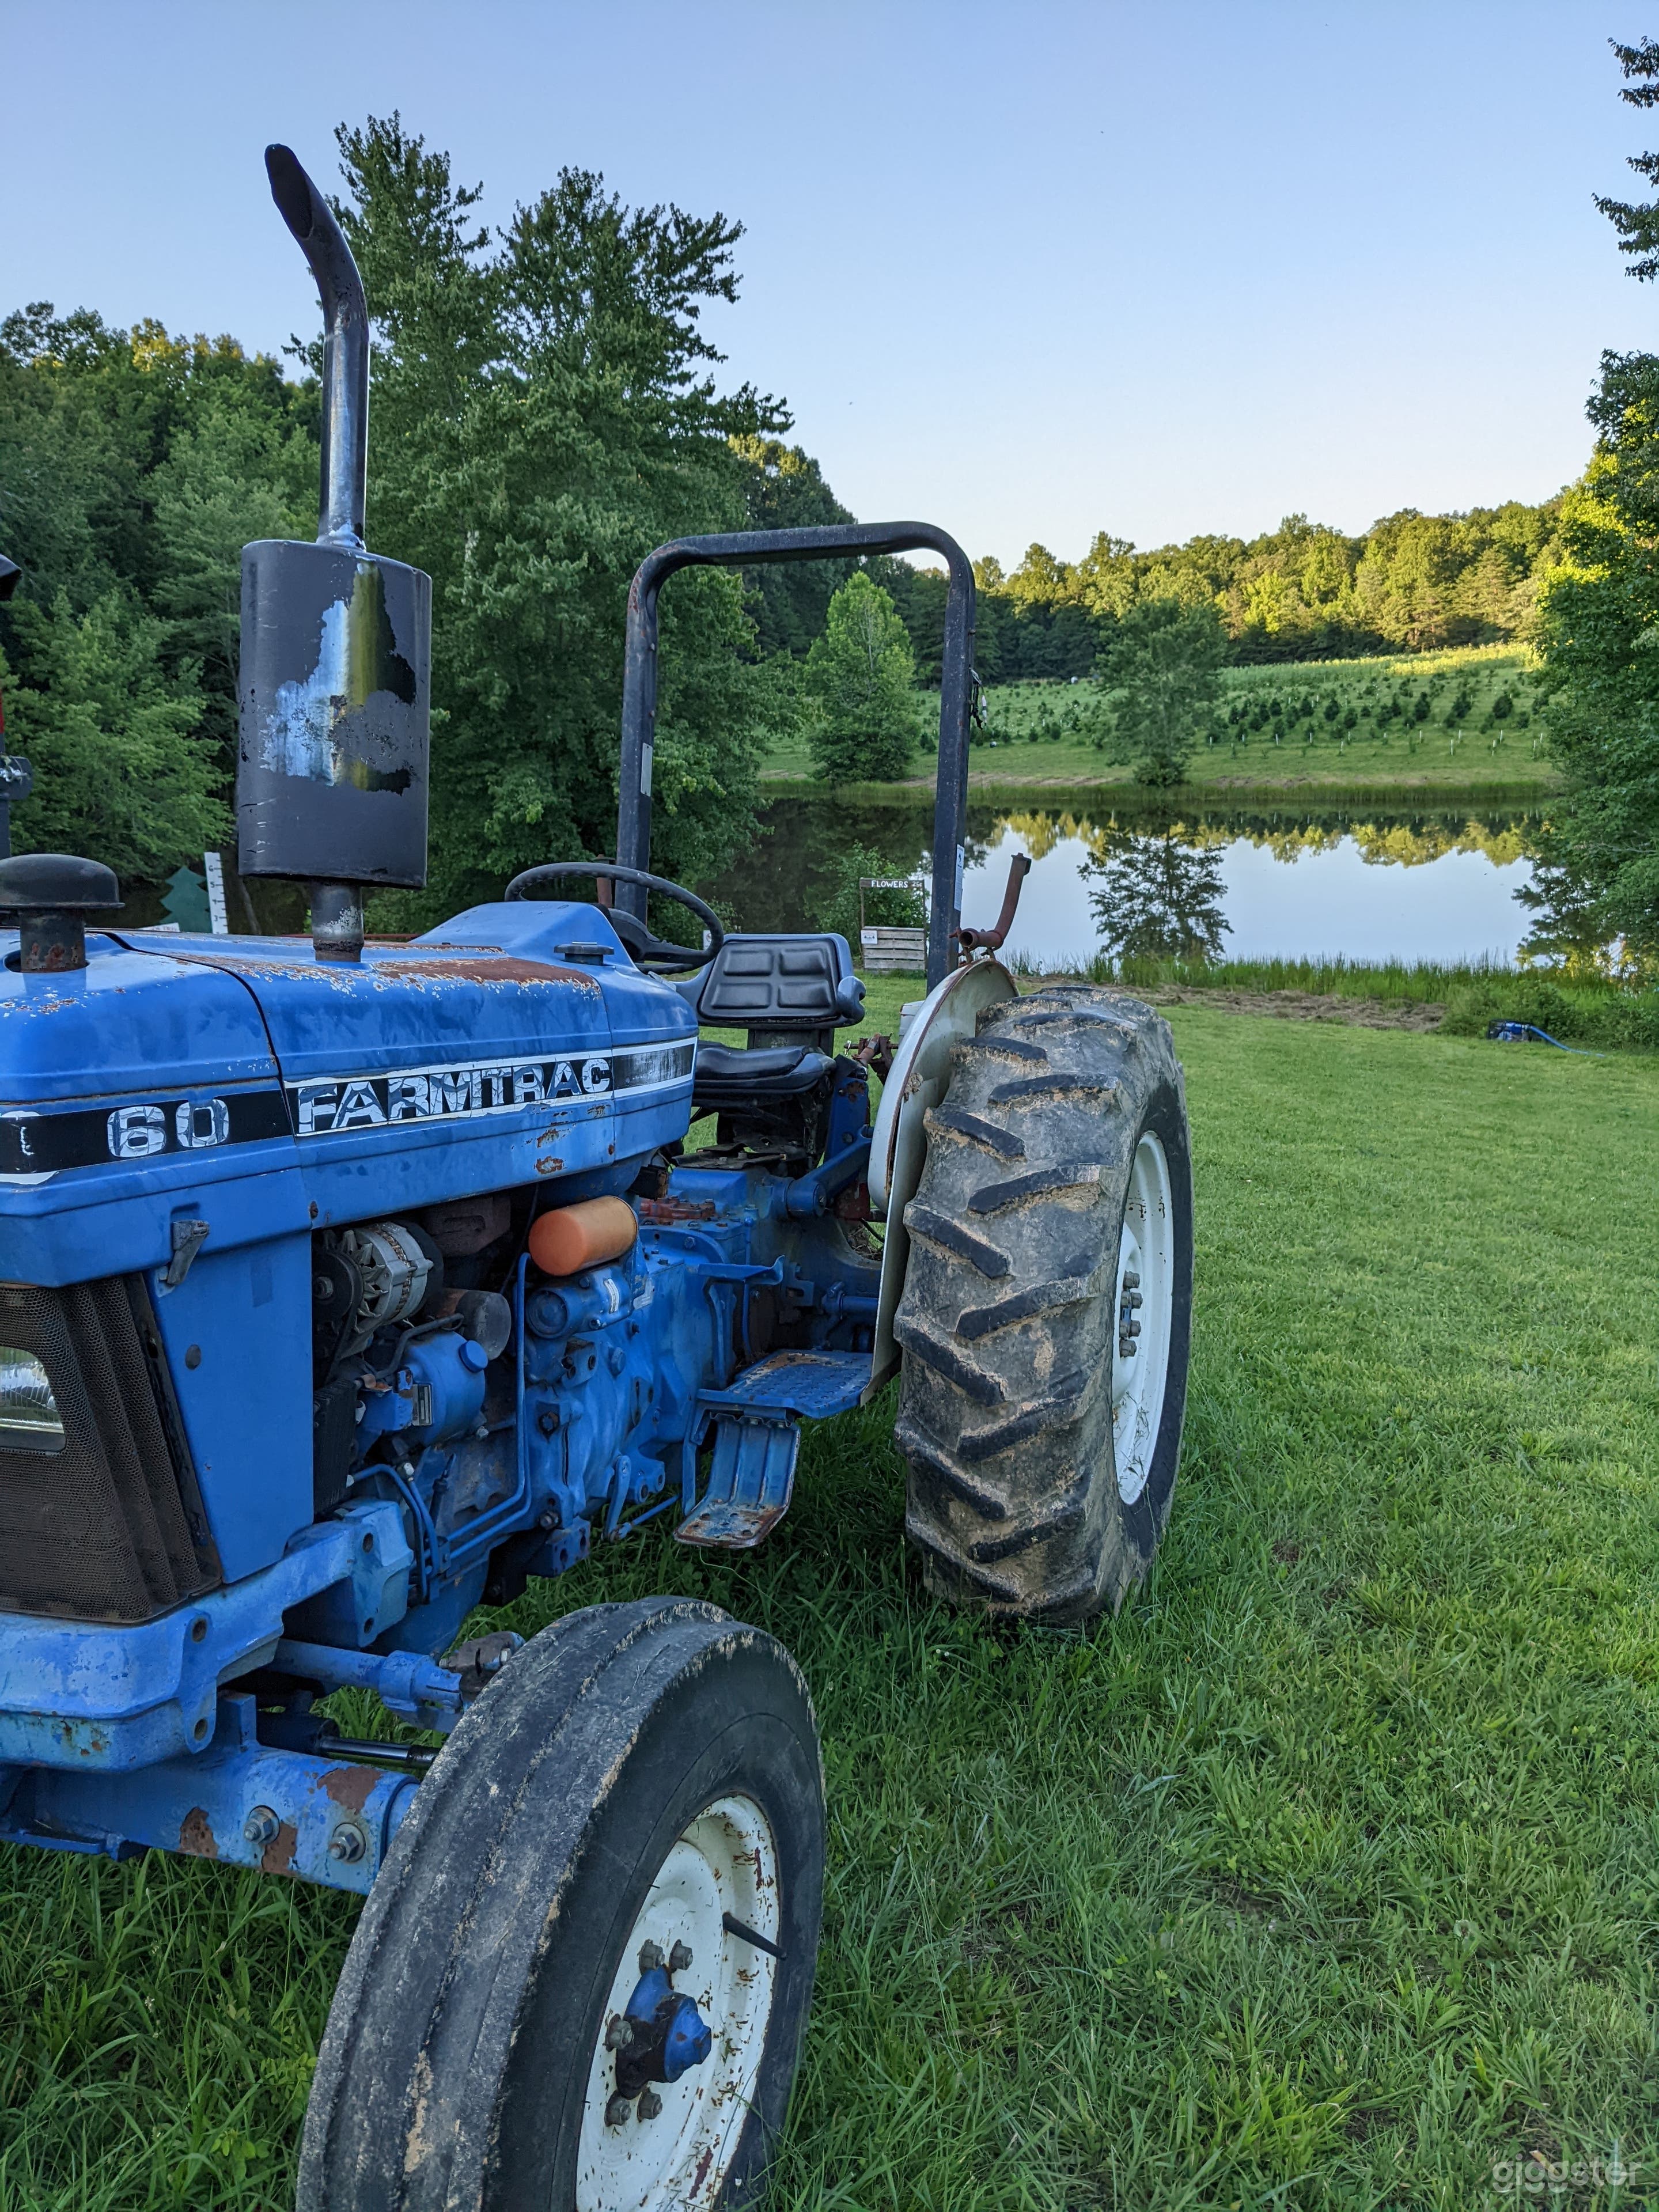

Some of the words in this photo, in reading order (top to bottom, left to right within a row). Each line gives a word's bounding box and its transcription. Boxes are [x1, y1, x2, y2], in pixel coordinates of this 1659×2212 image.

[871, 880, 908, 888] FLOWERS
[107, 1099, 229, 1157] 60
[298, 1058, 611, 1134] FARMTRAC
